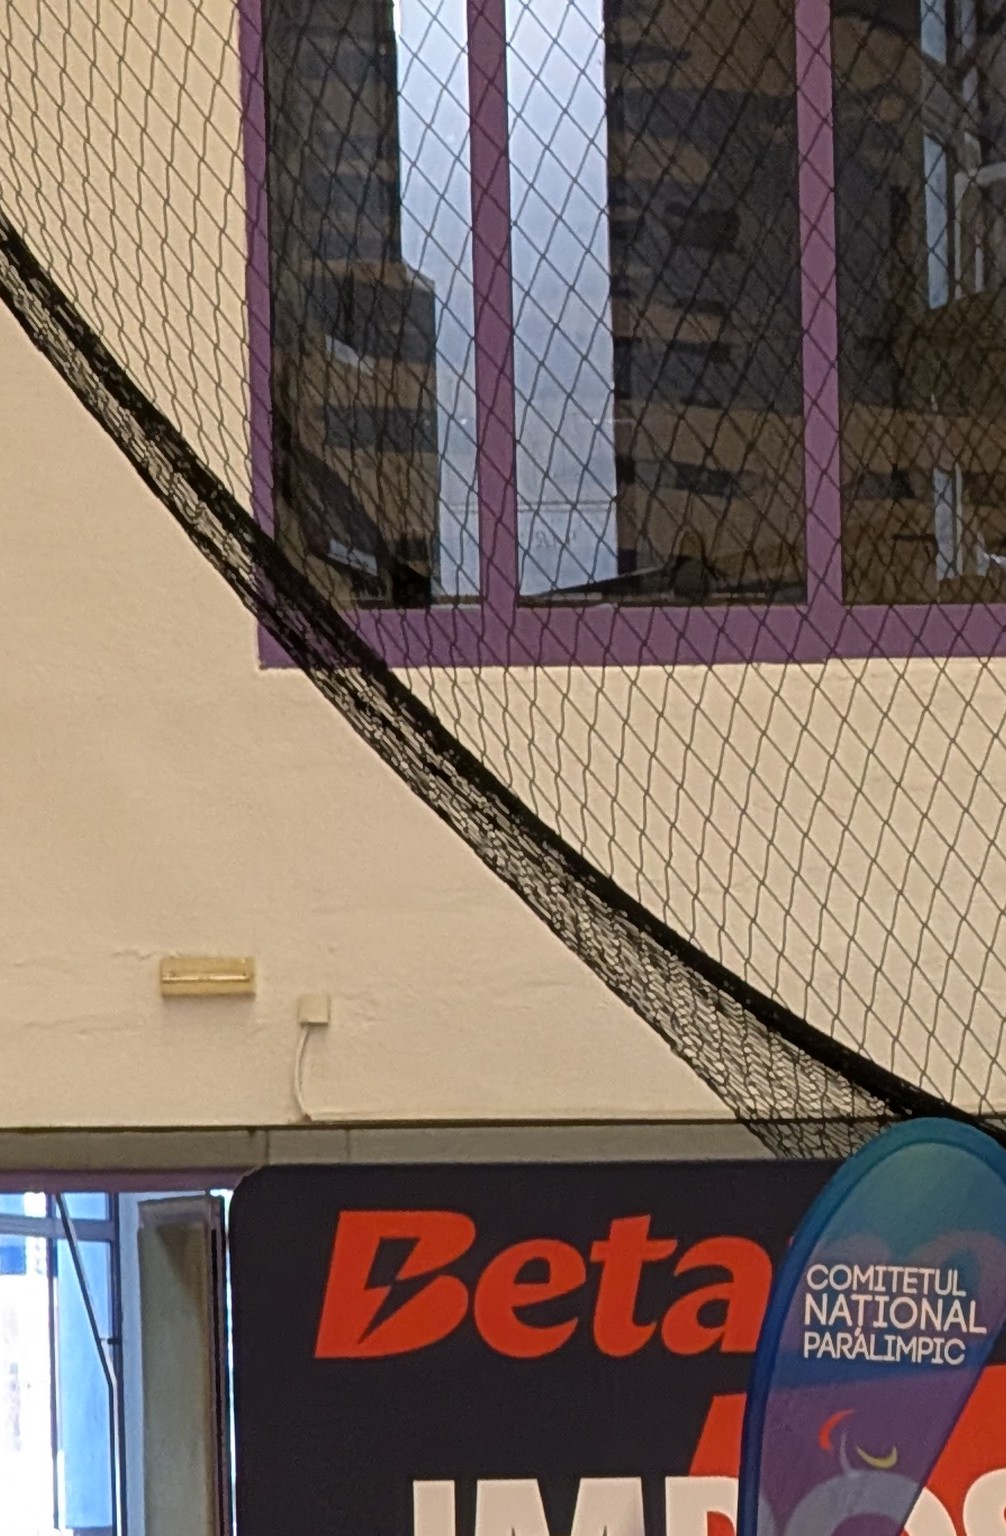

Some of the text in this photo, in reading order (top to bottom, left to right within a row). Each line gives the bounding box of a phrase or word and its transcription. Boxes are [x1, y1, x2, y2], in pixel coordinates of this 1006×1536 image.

[806, 1263, 967, 1297] COMITETUL
[804, 1292, 987, 1337] NAȚIONAL
[803, 1331, 966, 1366] PARALIMPIC
